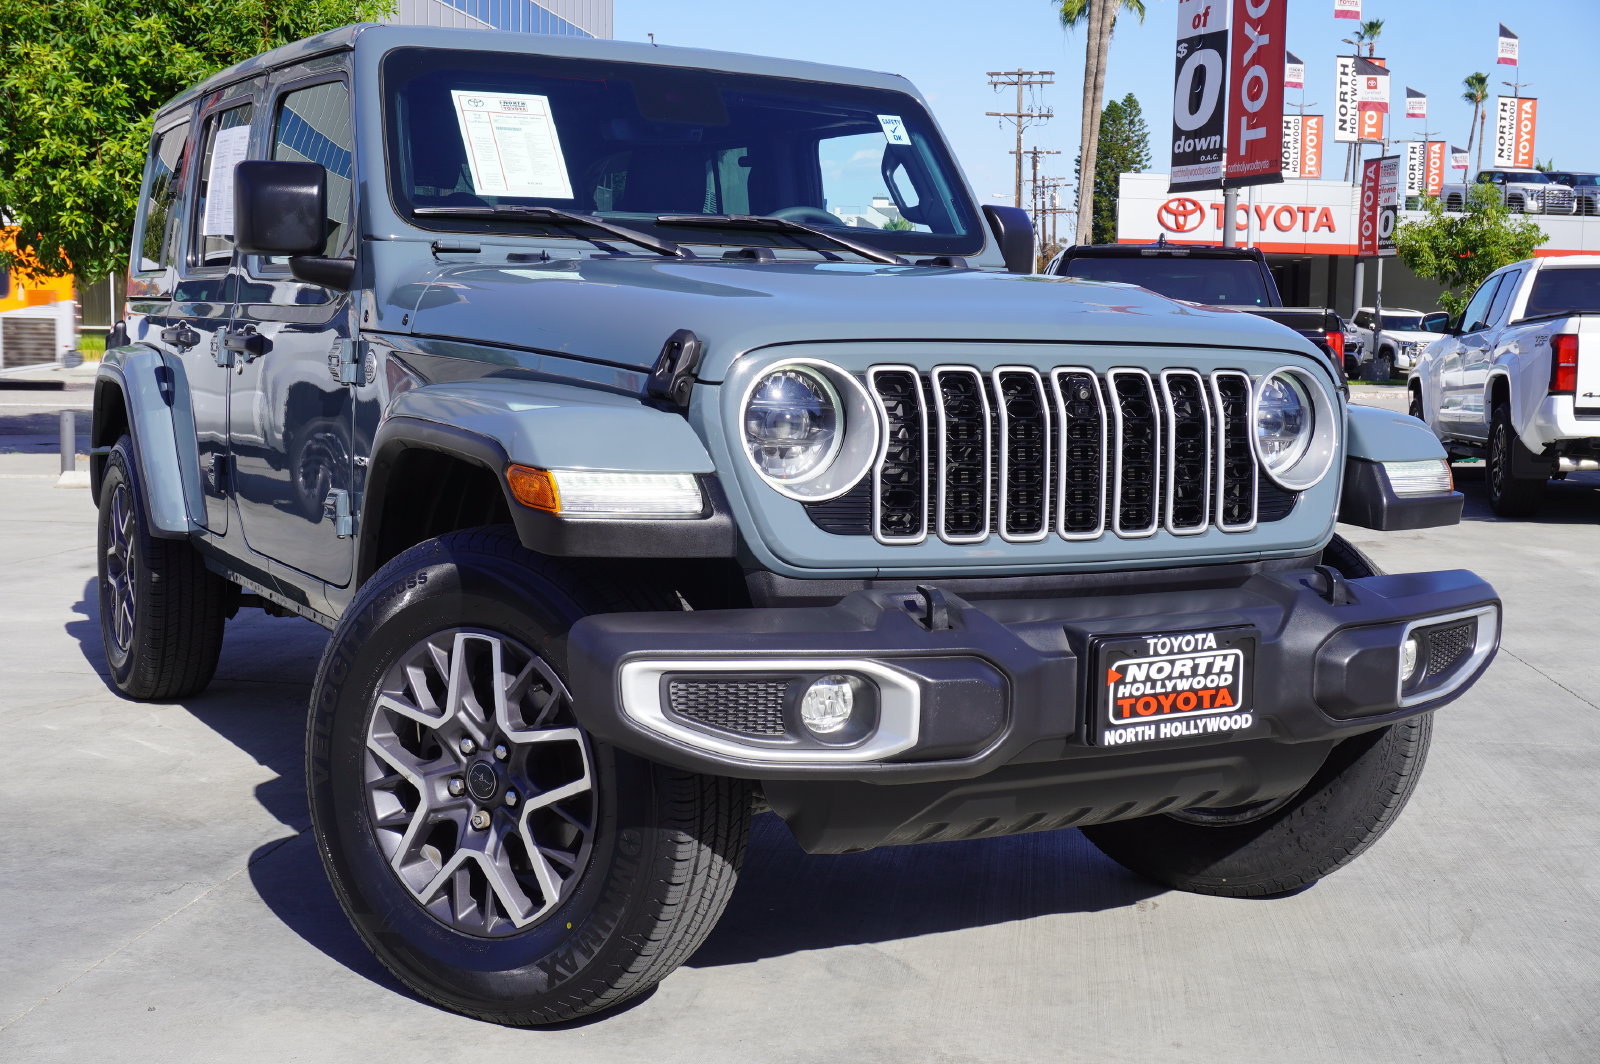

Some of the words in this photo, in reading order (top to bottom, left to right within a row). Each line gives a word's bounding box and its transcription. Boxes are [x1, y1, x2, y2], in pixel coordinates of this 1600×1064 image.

[1192, 6, 1211, 30] of
[1338, 63, 1349, 131] NORTH
[1174, 134, 1221, 153] down
[1282, 120, 1292, 170] NORTH
[1292, 118, 1300, 172] HOLLYWOOD
[1305, 118, 1318, 173] TOYOTA
[1498, 102, 1508, 158] NORTH
[1507, 100, 1516, 160] HOLLYWOOD
[1518, 101, 1533, 162] TOYOTA
[1408, 146, 1417, 190] NORTH
[1429, 143, 1441, 191] TOYOTA
[1211, 203, 1336, 232] TOYOTA
[1361, 163, 1377, 250] TOYOTA
[1383, 196, 1391, 204] of
[1147, 633, 1217, 655] TOYOTA
[1117, 674, 1233, 697] HOLLYWOOD
[1125, 655, 1235, 682] NORTH
[1117, 688, 1233, 718] TOYOTA
[1104, 725, 1155, 745] NORTH
[1160, 714, 1252, 738] HOLLYWOOD
